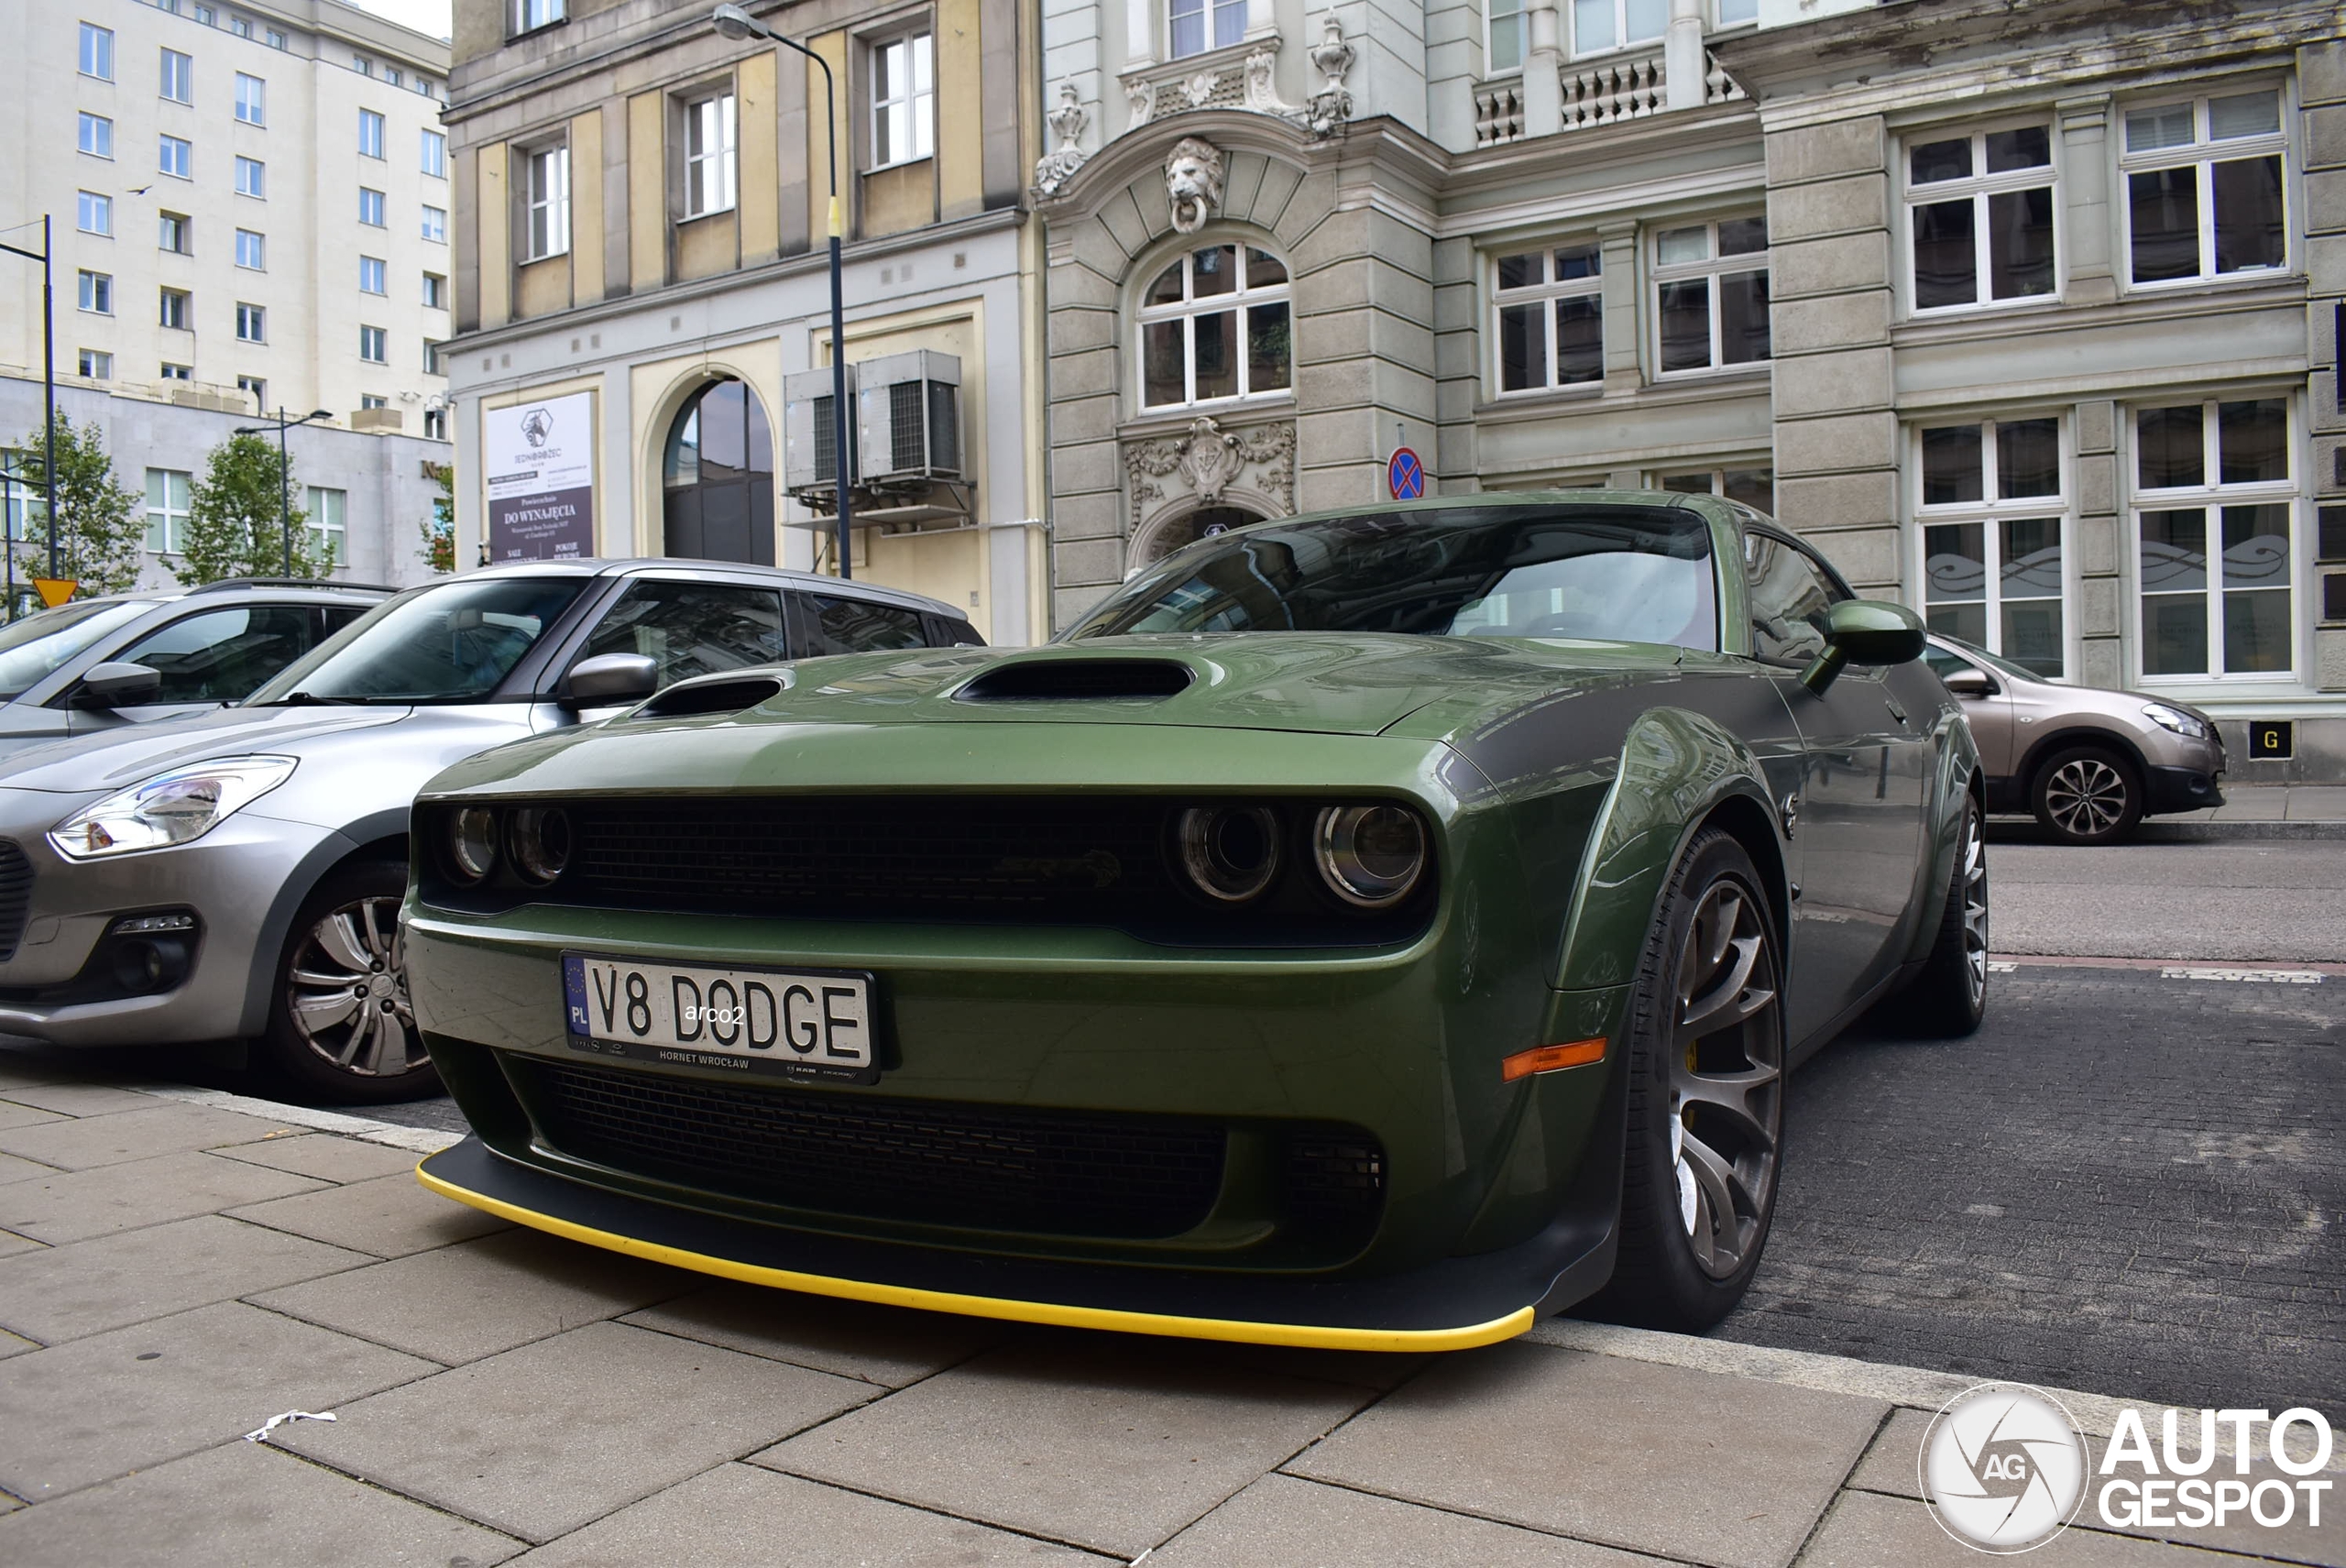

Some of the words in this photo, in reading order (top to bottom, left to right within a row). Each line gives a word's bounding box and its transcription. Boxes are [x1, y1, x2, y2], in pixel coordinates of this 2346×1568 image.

[504, 512, 519, 524] DO
[520, 504, 576, 522] WYNAJĘCIA
[2264, 730, 2278, 749] G
[572, 1005, 587, 1025] PL
[593, 967, 652, 1036] V8
[672, 974, 861, 1058] DODGE
[660, 1049, 696, 1064] HORNET
[698, 1053, 750, 1069] WROCŁAW
